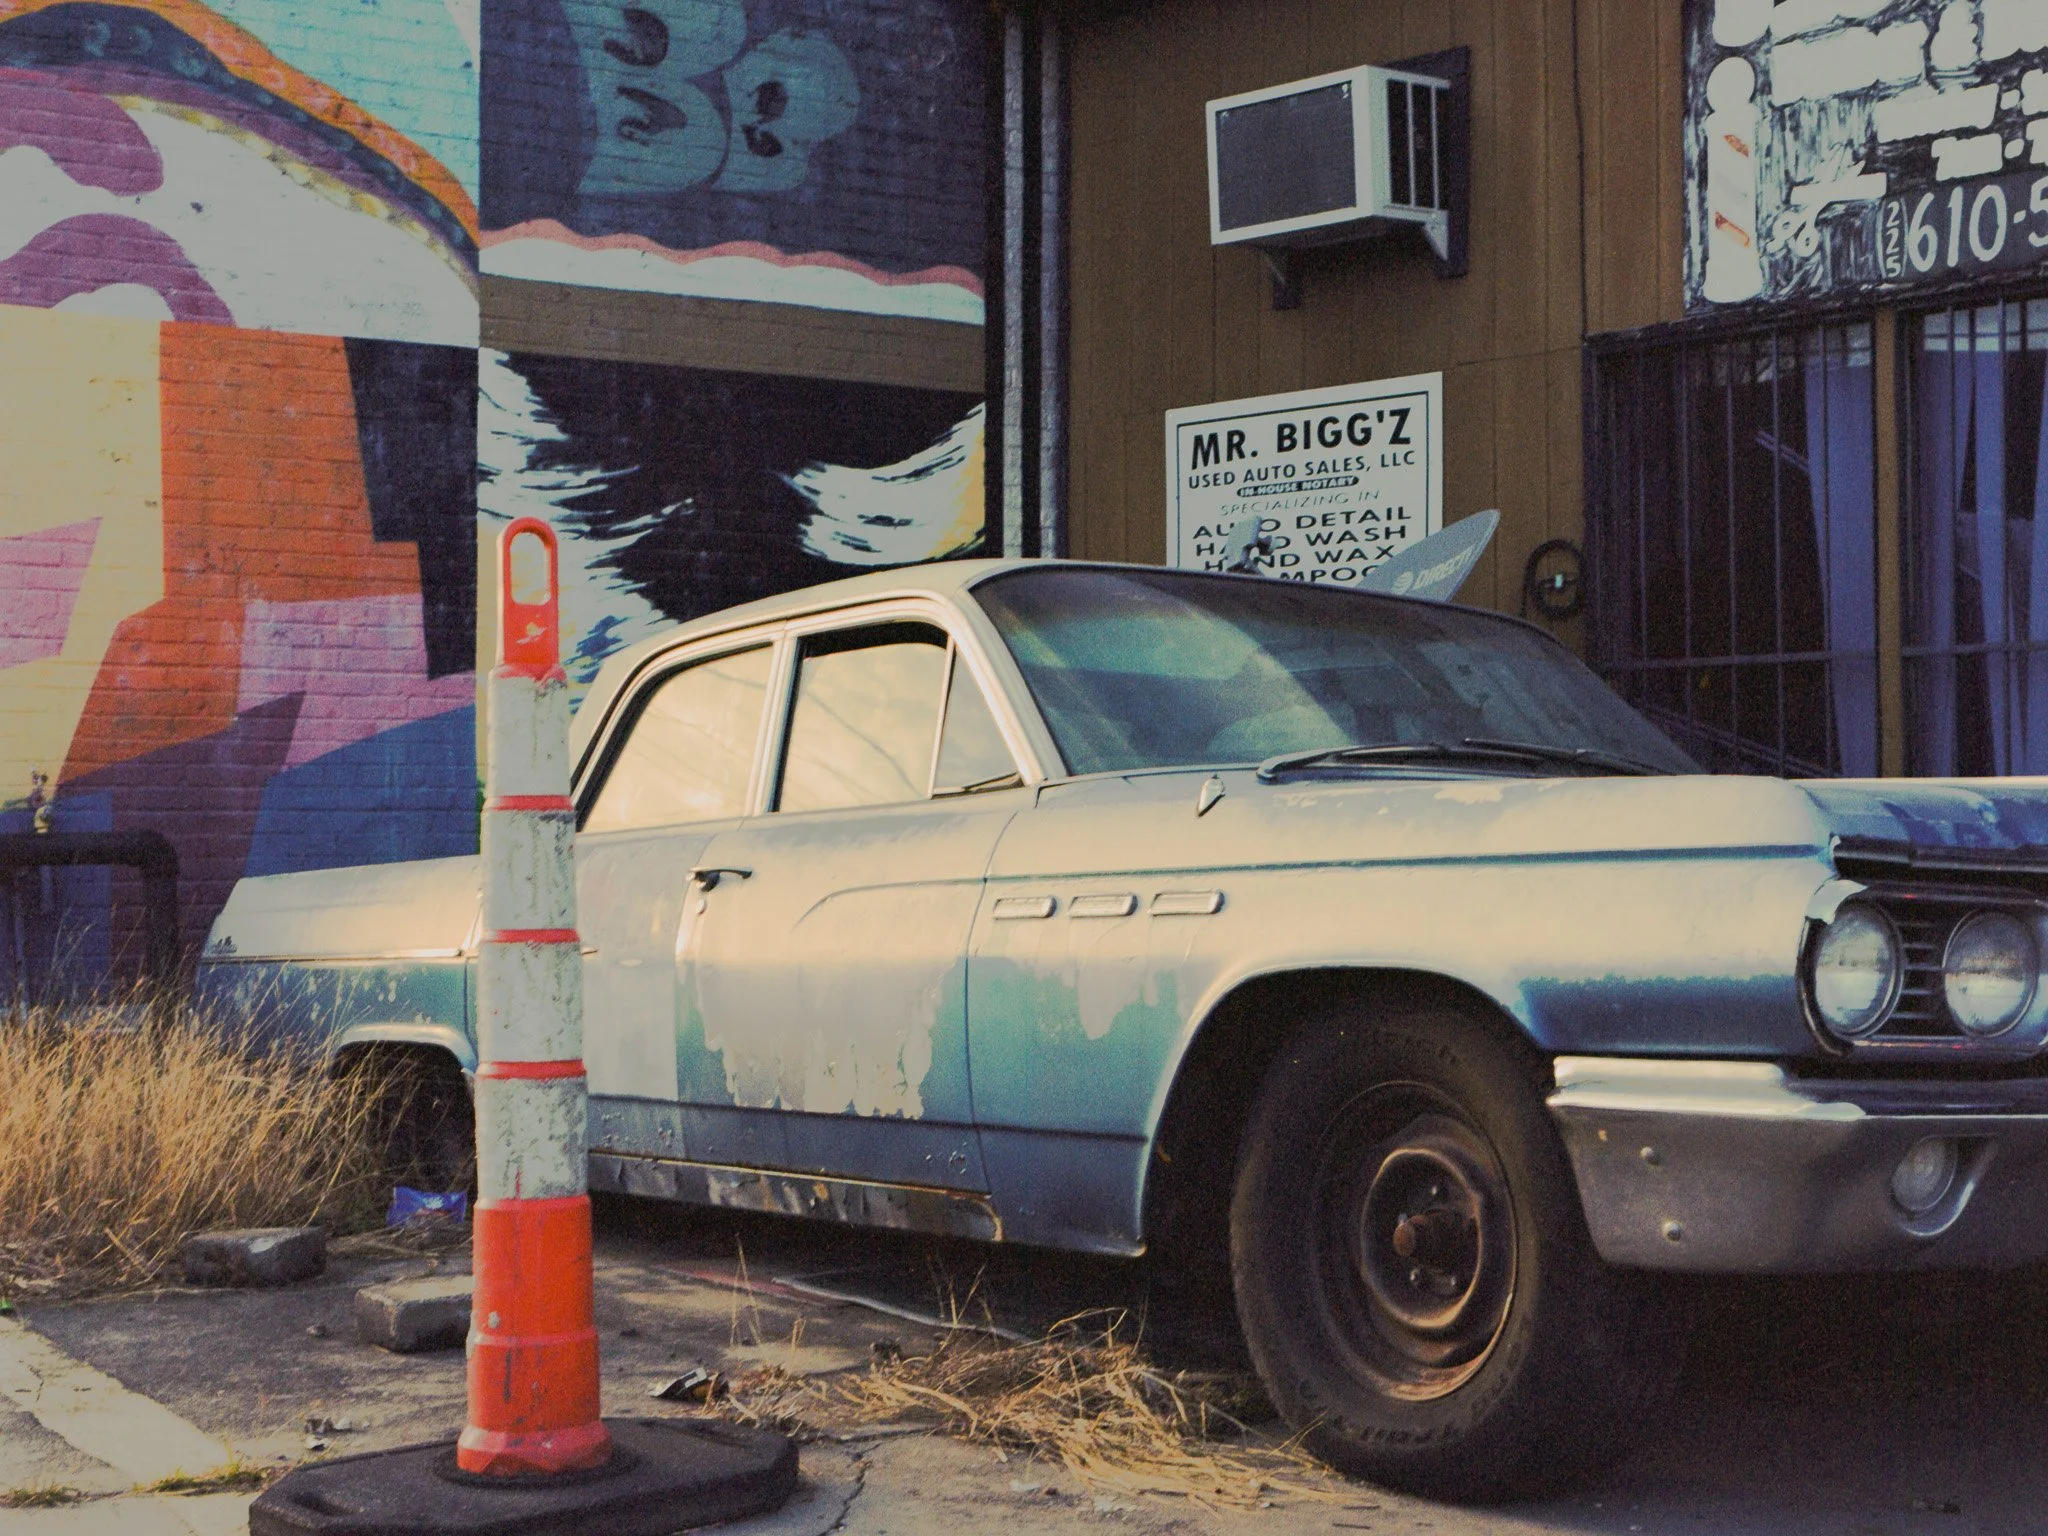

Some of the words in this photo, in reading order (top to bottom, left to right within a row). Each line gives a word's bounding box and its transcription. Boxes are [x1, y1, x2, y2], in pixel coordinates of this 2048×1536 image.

[1191, 429, 1259, 470] MR.
[1276, 407, 1412, 454] BIGG'Z
[1188, 470, 1236, 489] USED
[1243, 464, 1297, 483] AUTO
[1305, 455, 1371, 476] SALES,
[1380, 450, 1416, 468] LLC
[1300, 476, 1356, 491] NOTARY
[1221, 492, 1350, 516] SPECIALIZING
[1358, 489, 1380, 502] IN
[1192, 518, 1282, 539] AUO
[1296, 506, 1412, 529] DETAIL
[1196, 536, 1291, 556] HD
[1305, 525, 1406, 546] WASH
[1204, 553, 1300, 571] HND
[1314, 544, 1396, 564] WAX
